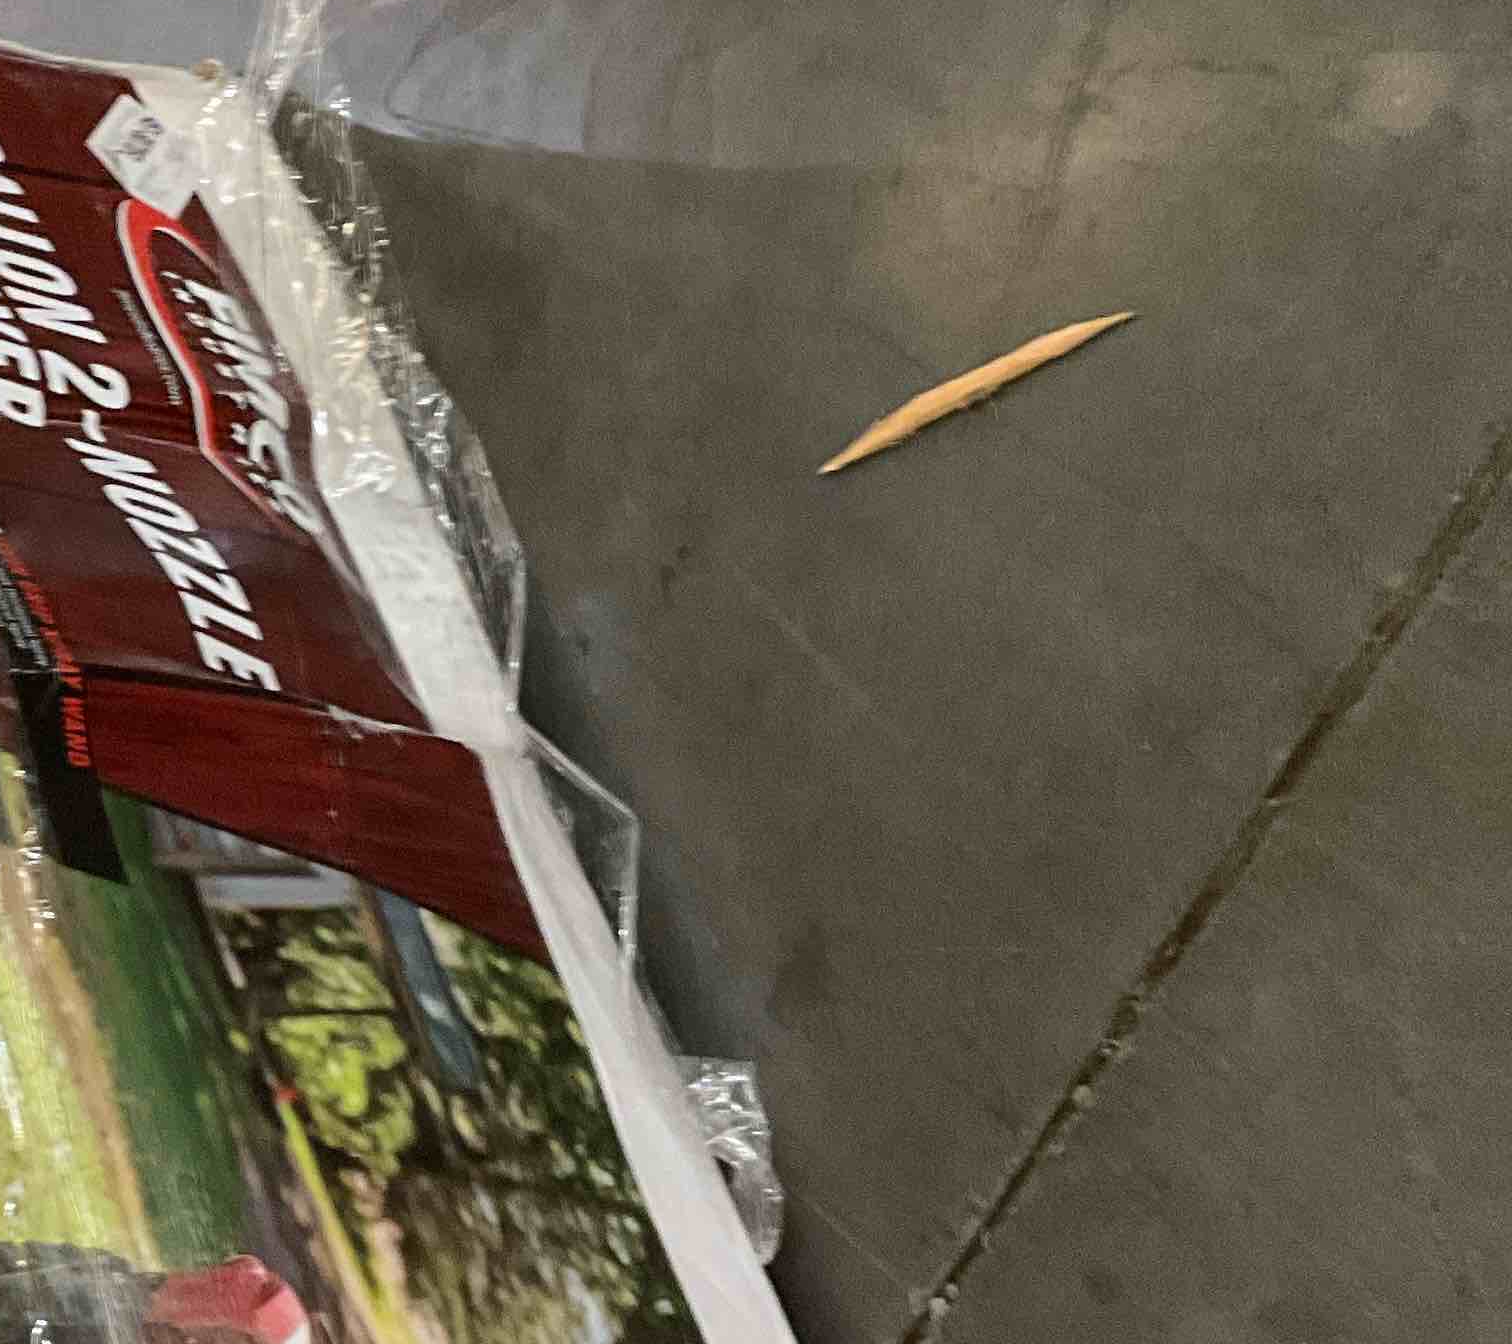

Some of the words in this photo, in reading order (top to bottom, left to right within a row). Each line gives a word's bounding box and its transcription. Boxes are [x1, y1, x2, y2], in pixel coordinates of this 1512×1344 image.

[39, 346, 282, 693] 2-NOZZLE
[184, 278, 324, 536] FIMCO
[62, 696, 91, 768] WAND
